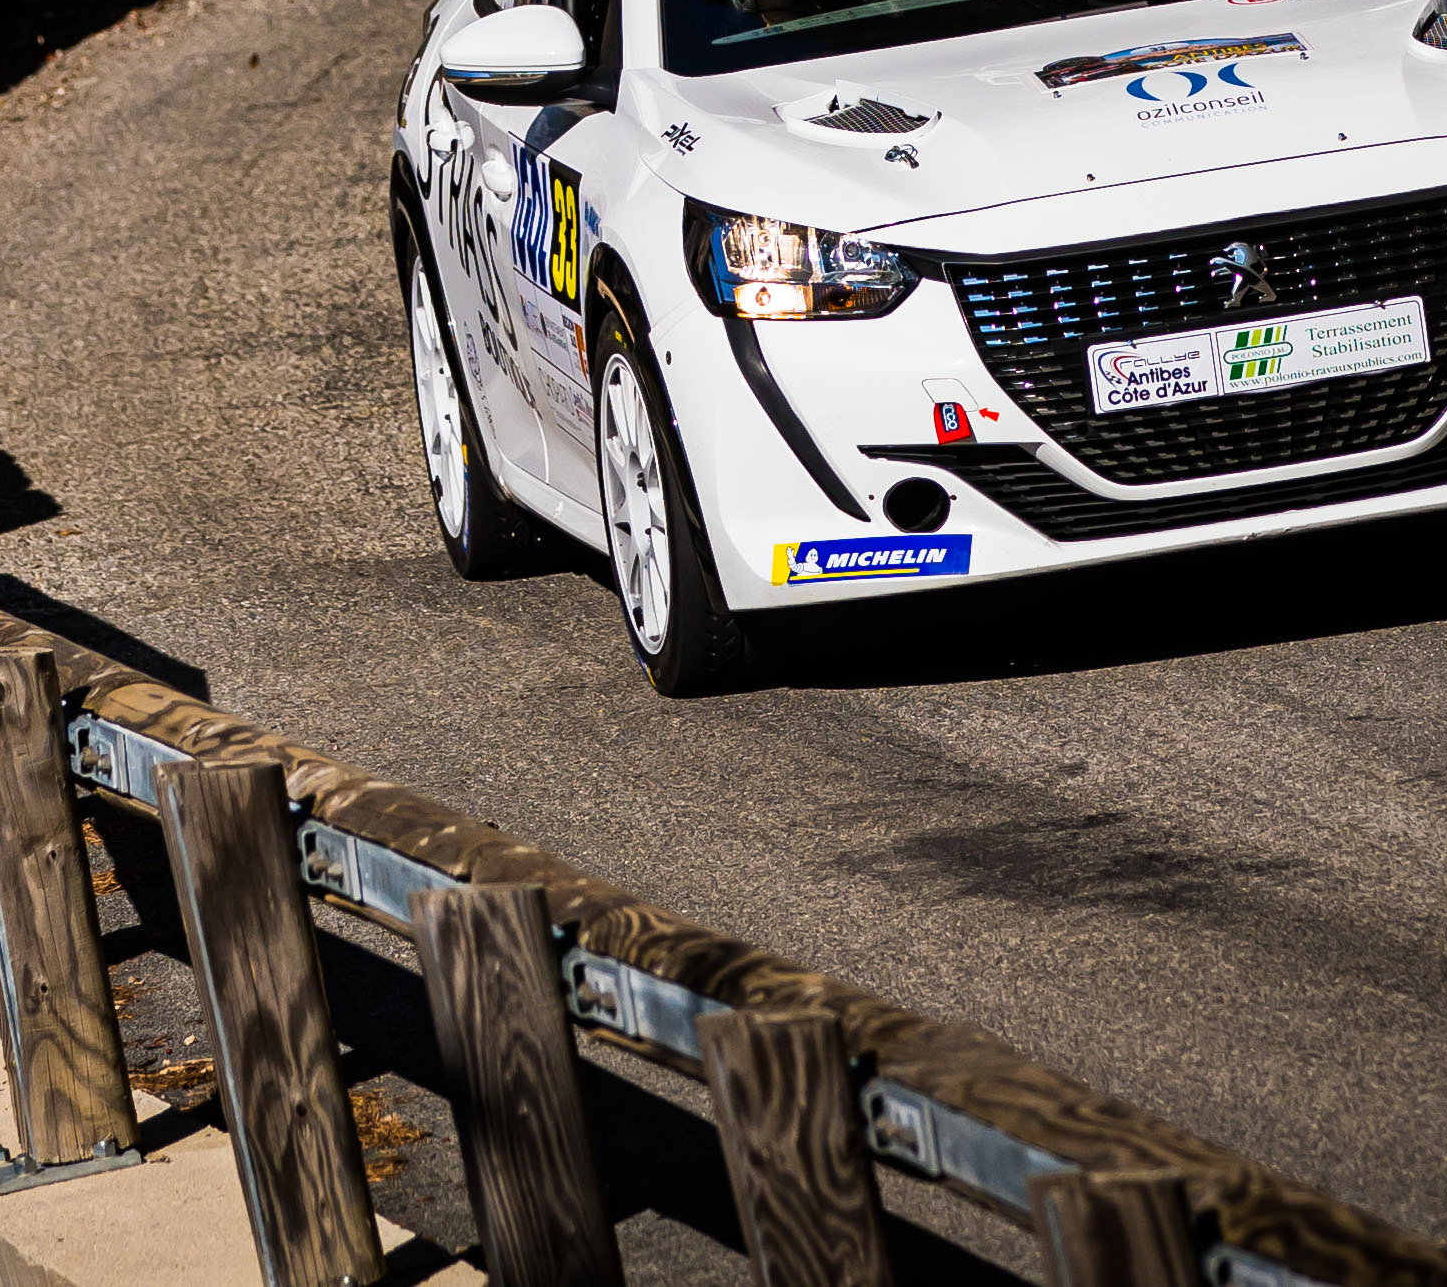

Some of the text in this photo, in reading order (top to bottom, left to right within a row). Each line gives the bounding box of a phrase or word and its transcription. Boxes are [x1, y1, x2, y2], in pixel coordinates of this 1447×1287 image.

[1137, 91, 1265, 121] ozilconseil
[1141, 104, 1269, 128] COMMUNICATION
[552, 179, 577, 300] 33
[1305, 313, 1413, 341] Terrassement
[1231, 348, 1271, 361] POLONIO
[1311, 332, 1413, 358] Stabilisation
[1127, 365, 1191, 386] Antibes
[1229, 350, 1424, 389] www.polonio-travauxpublics.com
[1107, 378, 1208, 406] Côte d'Azur
[825, 548, 947, 569] MICHELIN
